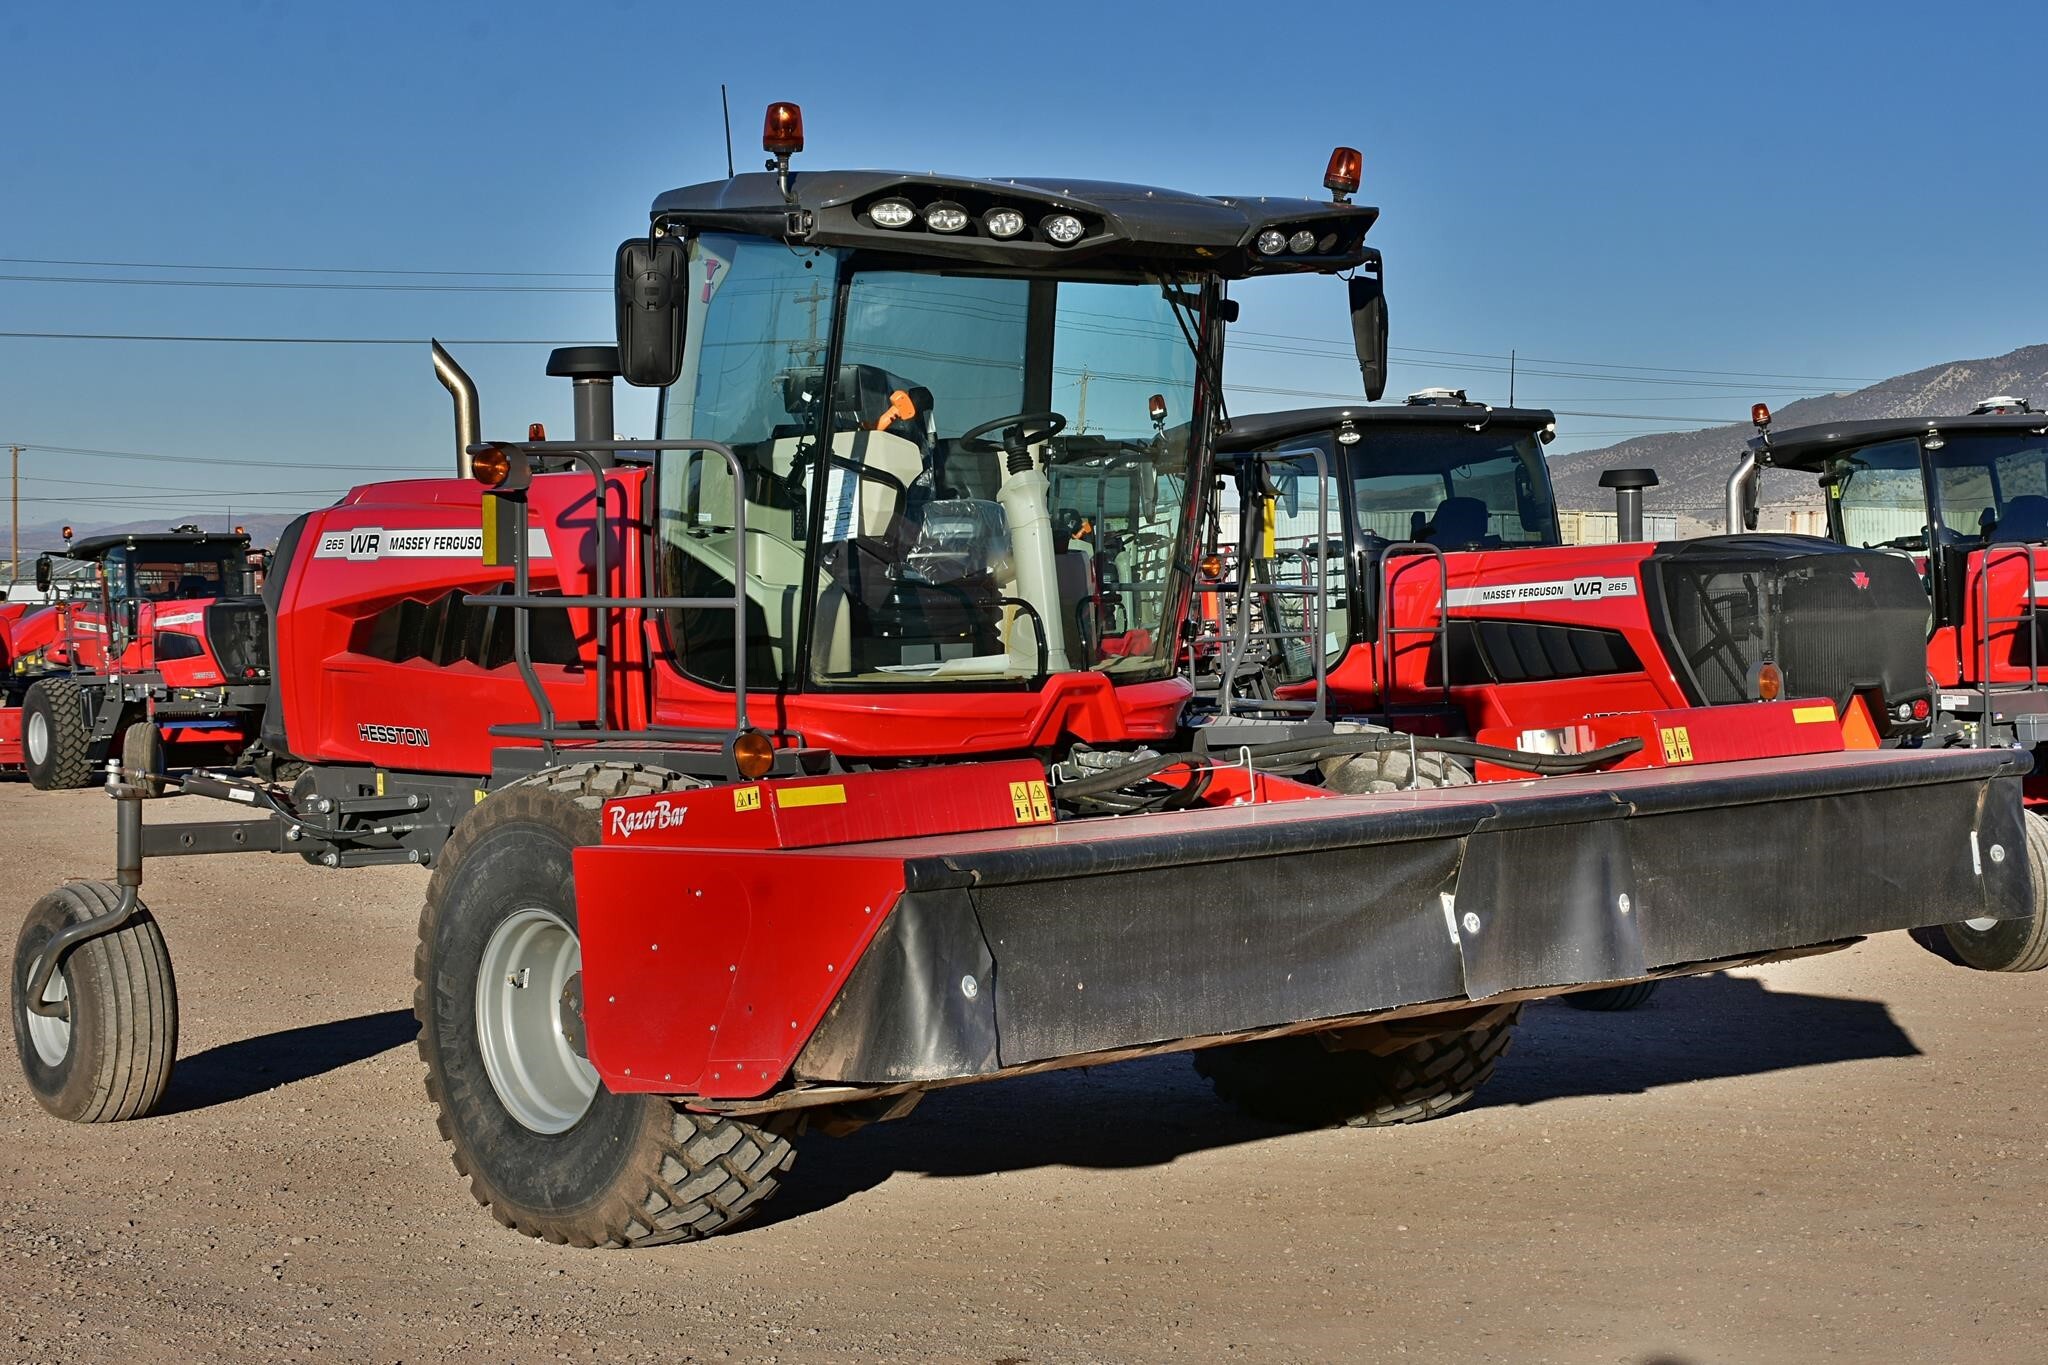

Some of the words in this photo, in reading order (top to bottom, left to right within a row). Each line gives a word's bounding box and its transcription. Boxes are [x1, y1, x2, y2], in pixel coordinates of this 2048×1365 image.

[325, 538, 344, 551] 265
[350, 534, 381, 554] WR
[389, 536, 431, 550] MASSEY
[433, 535, 484, 550] FERGUSO
[1482, 588, 1516, 601] MASSEY
[1518, 585, 1564, 598] FERGUSON
[1573, 581, 1602, 596] WR
[1607, 582, 1628, 592] 265
[357, 723, 430, 747] HESSTON
[608, 800, 689, 839] RazorBar
